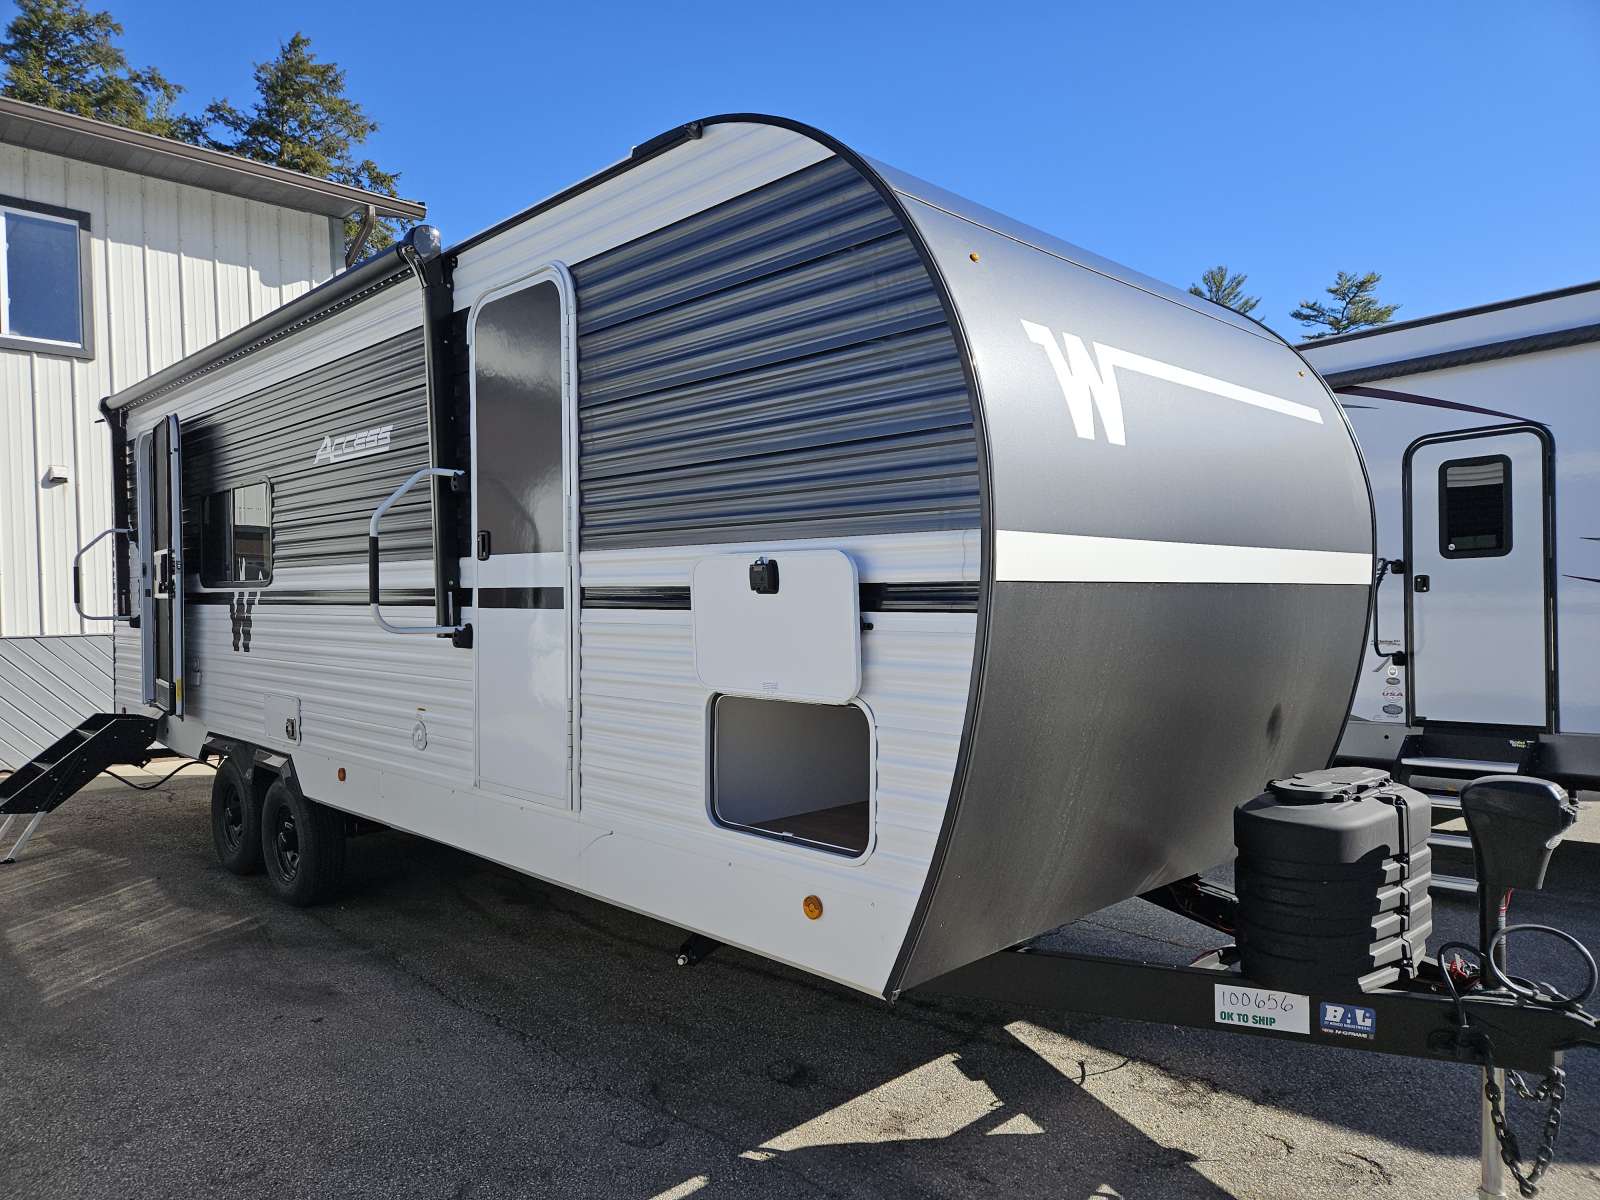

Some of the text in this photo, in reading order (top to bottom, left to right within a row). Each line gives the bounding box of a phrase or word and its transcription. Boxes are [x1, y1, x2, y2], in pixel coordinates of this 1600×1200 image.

[313, 424, 394, 465] ACCESS
[1222, 991, 1294, 1012] 100656
[1220, 1010, 1276, 1027] OK TO SHIP
